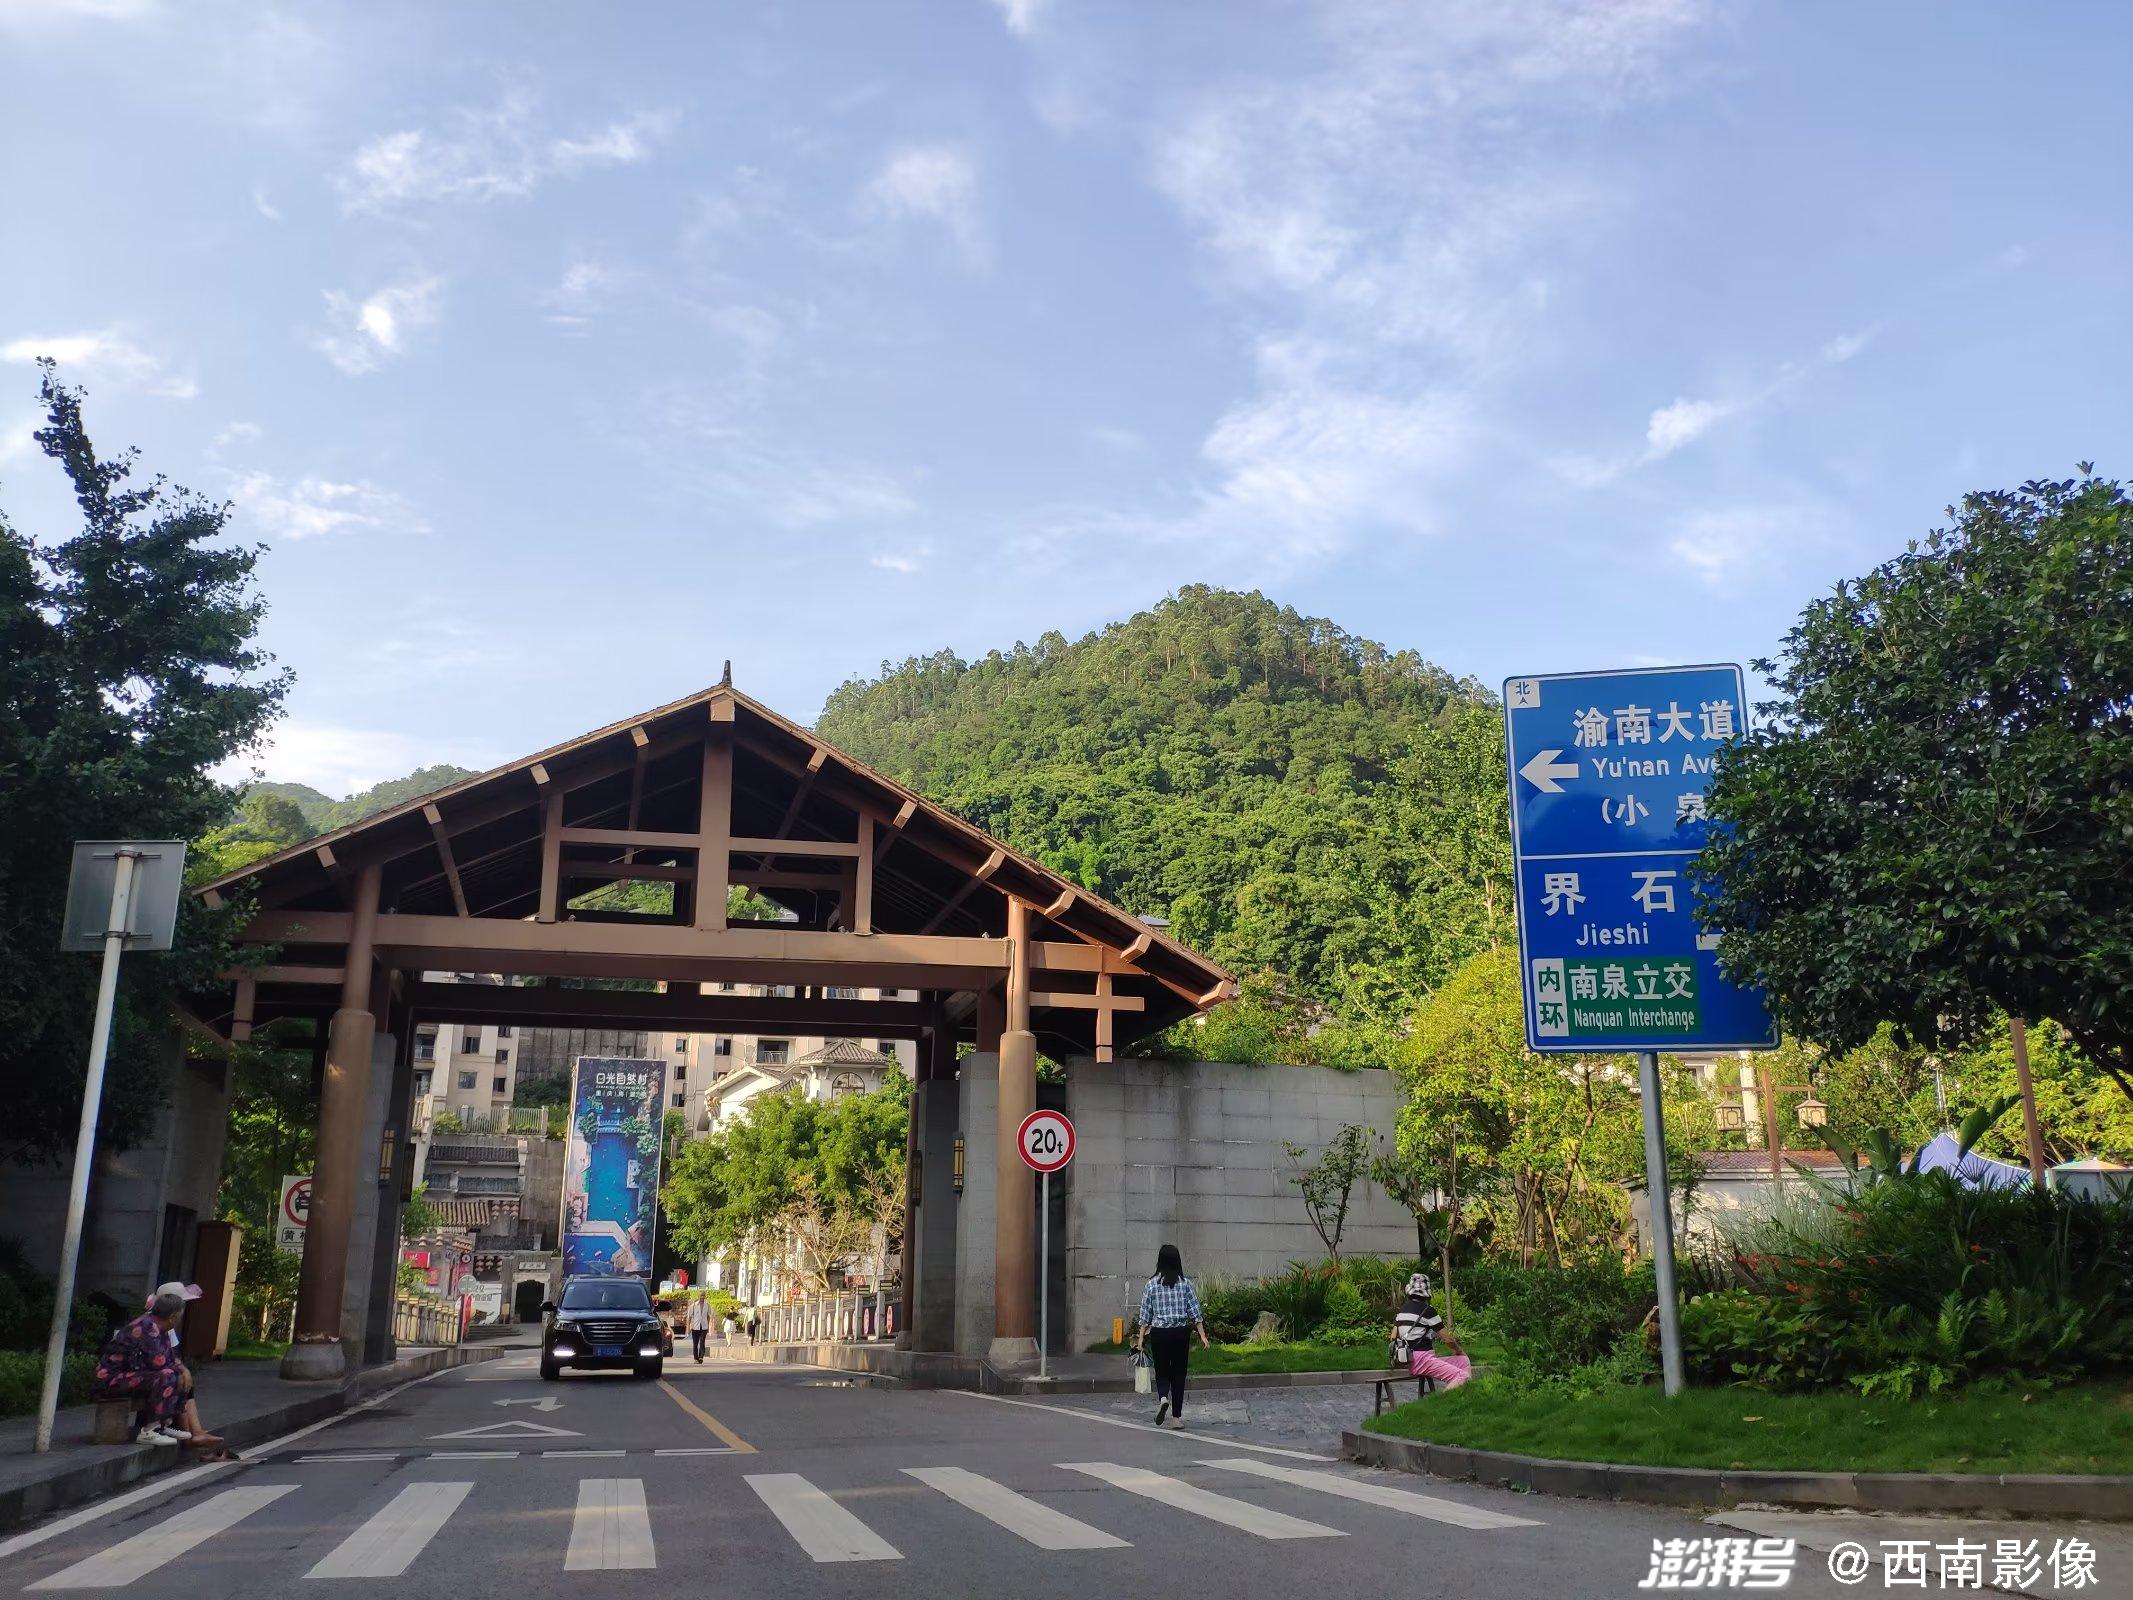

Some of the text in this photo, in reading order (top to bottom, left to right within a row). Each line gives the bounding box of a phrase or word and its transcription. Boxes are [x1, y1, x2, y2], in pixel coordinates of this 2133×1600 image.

[1515, 681, 1531, 695] 北
[1573, 699, 1736, 747] 渝南大道
[1592, 754, 1670, 778] Yu'nan
[1576, 922, 1649, 946] Jieshi
[1568, 963, 1695, 1001] 南泉立交
[1537, 966, 1564, 1029] 内环
[1574, 1007, 1695, 1031] Nanquan Interchange
[1031, 1128, 1063, 1154] 20t
